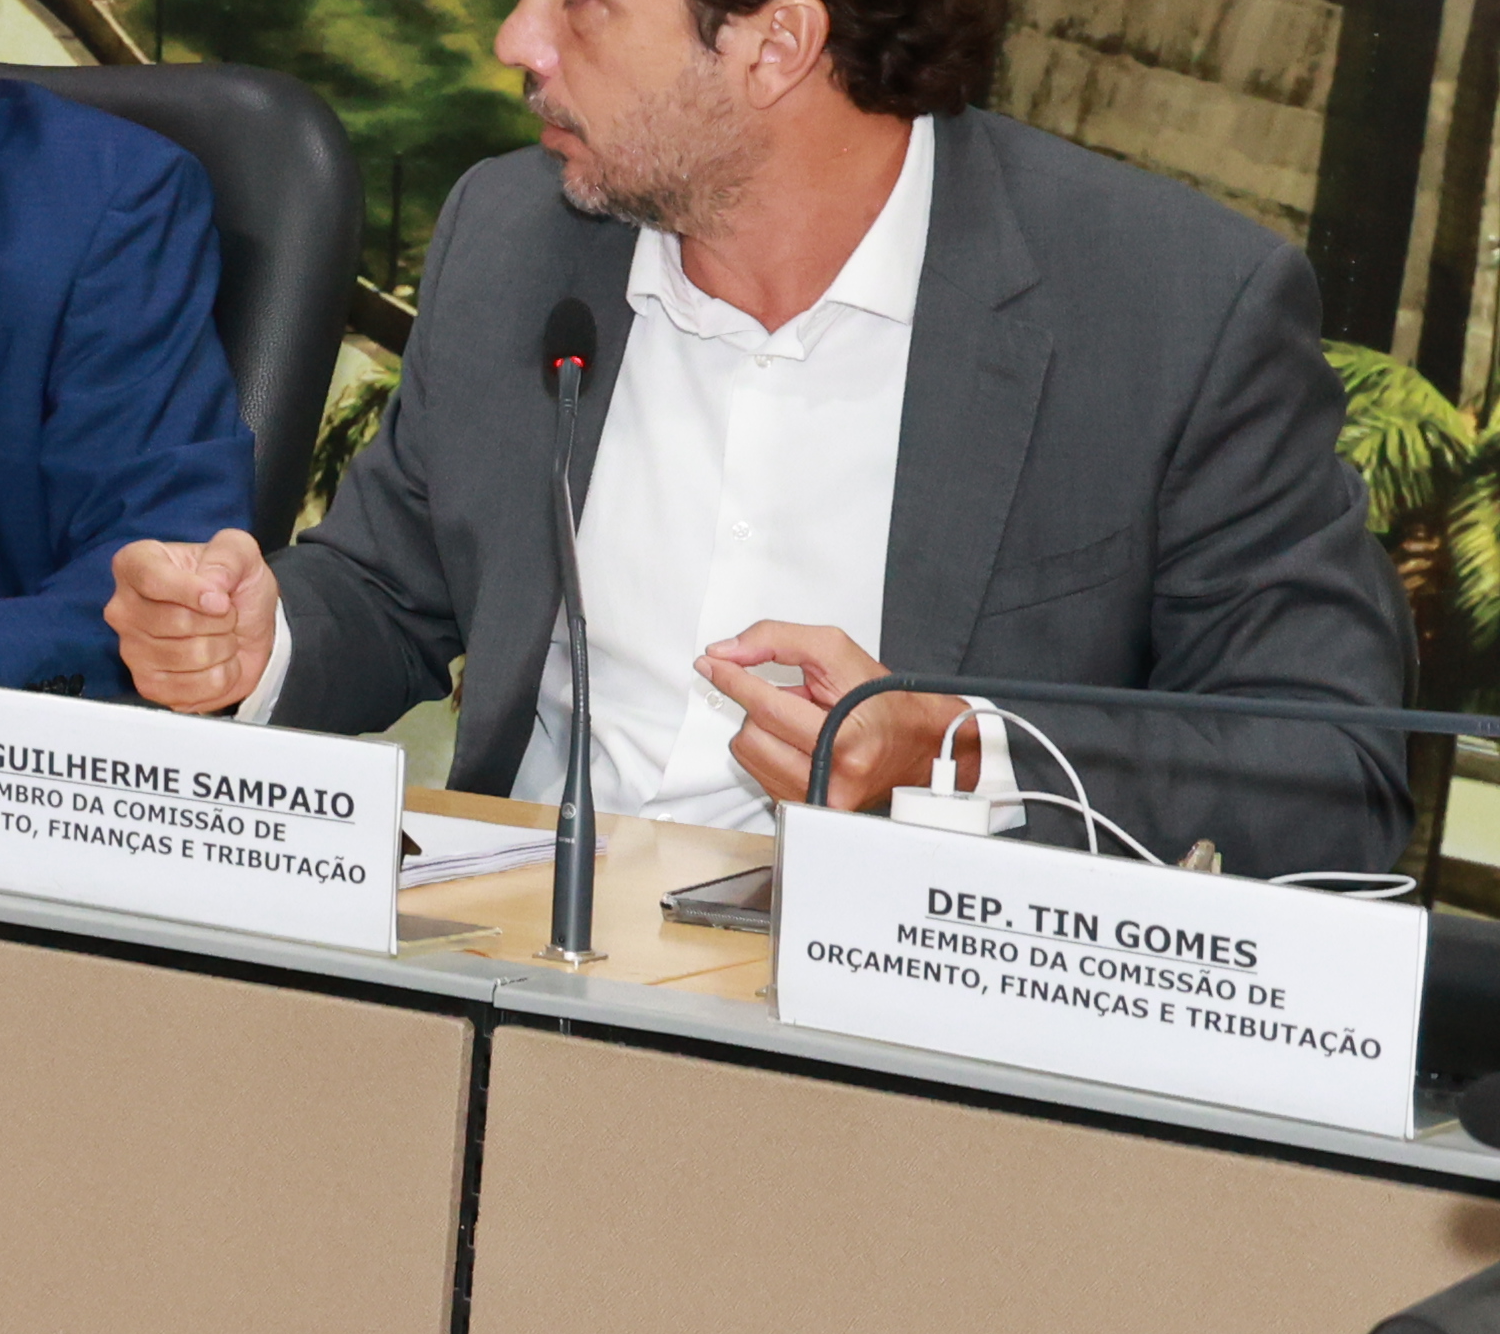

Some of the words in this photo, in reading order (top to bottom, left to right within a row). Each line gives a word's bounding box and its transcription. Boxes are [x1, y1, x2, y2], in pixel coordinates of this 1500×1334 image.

[73, 793, 104, 814] DA
[114, 800, 244, 835] COMISSÃO
[255, 820, 285, 841] DE
[193, 773, 354, 818] SAMPAIO
[49, 820, 172, 854] FINANÇAS
[182, 840, 193, 858] E
[203, 843, 365, 884] TRIBUTAÇÃO
[929, 888, 1012, 927] DEP.
[1029, 905, 1098, 941] TIN
[1115, 921, 1257, 967] GOMES
[808, 941, 987, 994] ORÇAMENTO,
[1001, 975, 1148, 1018] FINANÇAS
[1161, 1003, 1174, 1023] E
[1186, 1005, 1381, 1059] TRIBUTAÇÃO
[898, 924, 1018, 962] MEMBRO
[1030, 947, 1067, 972] DA
[1079, 957, 1236, 1000] COMISSÃO
[1249, 985, 1285, 1009] DE
